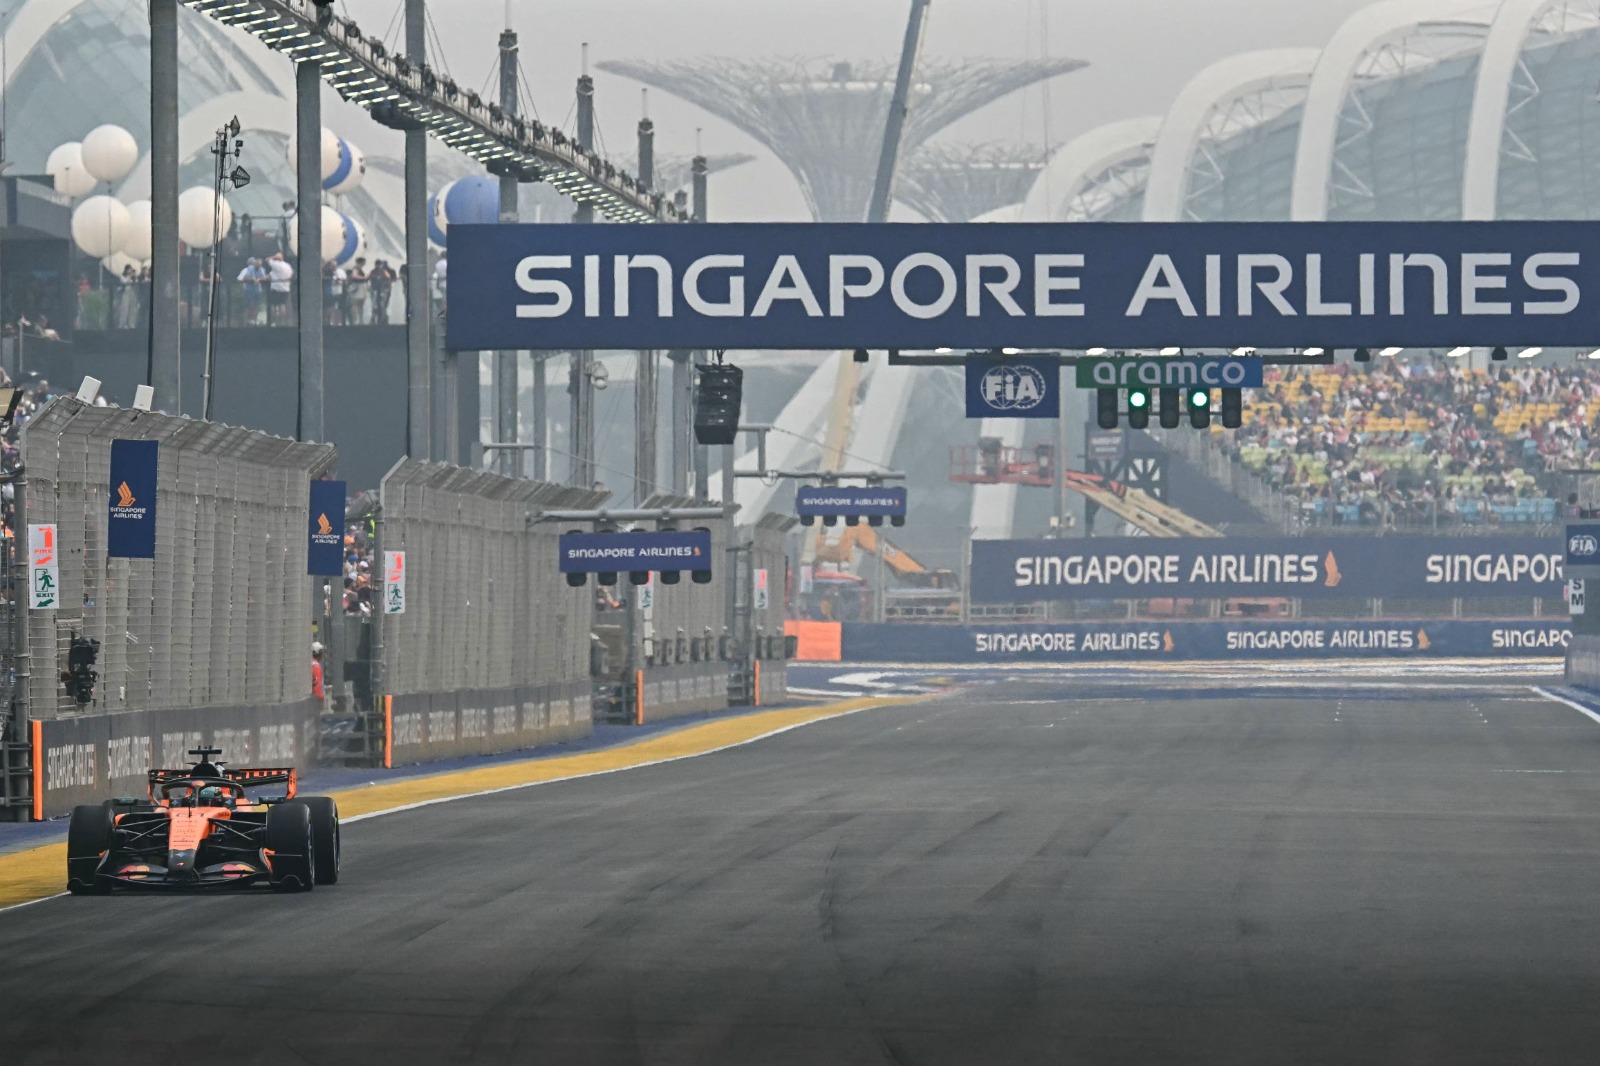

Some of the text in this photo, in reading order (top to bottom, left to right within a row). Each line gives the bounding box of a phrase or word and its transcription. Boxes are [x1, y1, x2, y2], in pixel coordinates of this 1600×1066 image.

[514, 252, 1580, 319] SINGAPORE AIRLINES
[1093, 361, 1246, 385] aramco
[109, 506, 146, 514] SINGAPORE
[568, 546, 692, 558] SINGAPORE AIRLINES
[1570, 539, 1594, 552] FIA
[1015, 554, 1319, 587] SINGAPORE AIRLINES
[975, 631, 1160, 652] SINGAPORE AIRLINES
[1226, 629, 1413, 650] SINGAPORE AIRLINES
